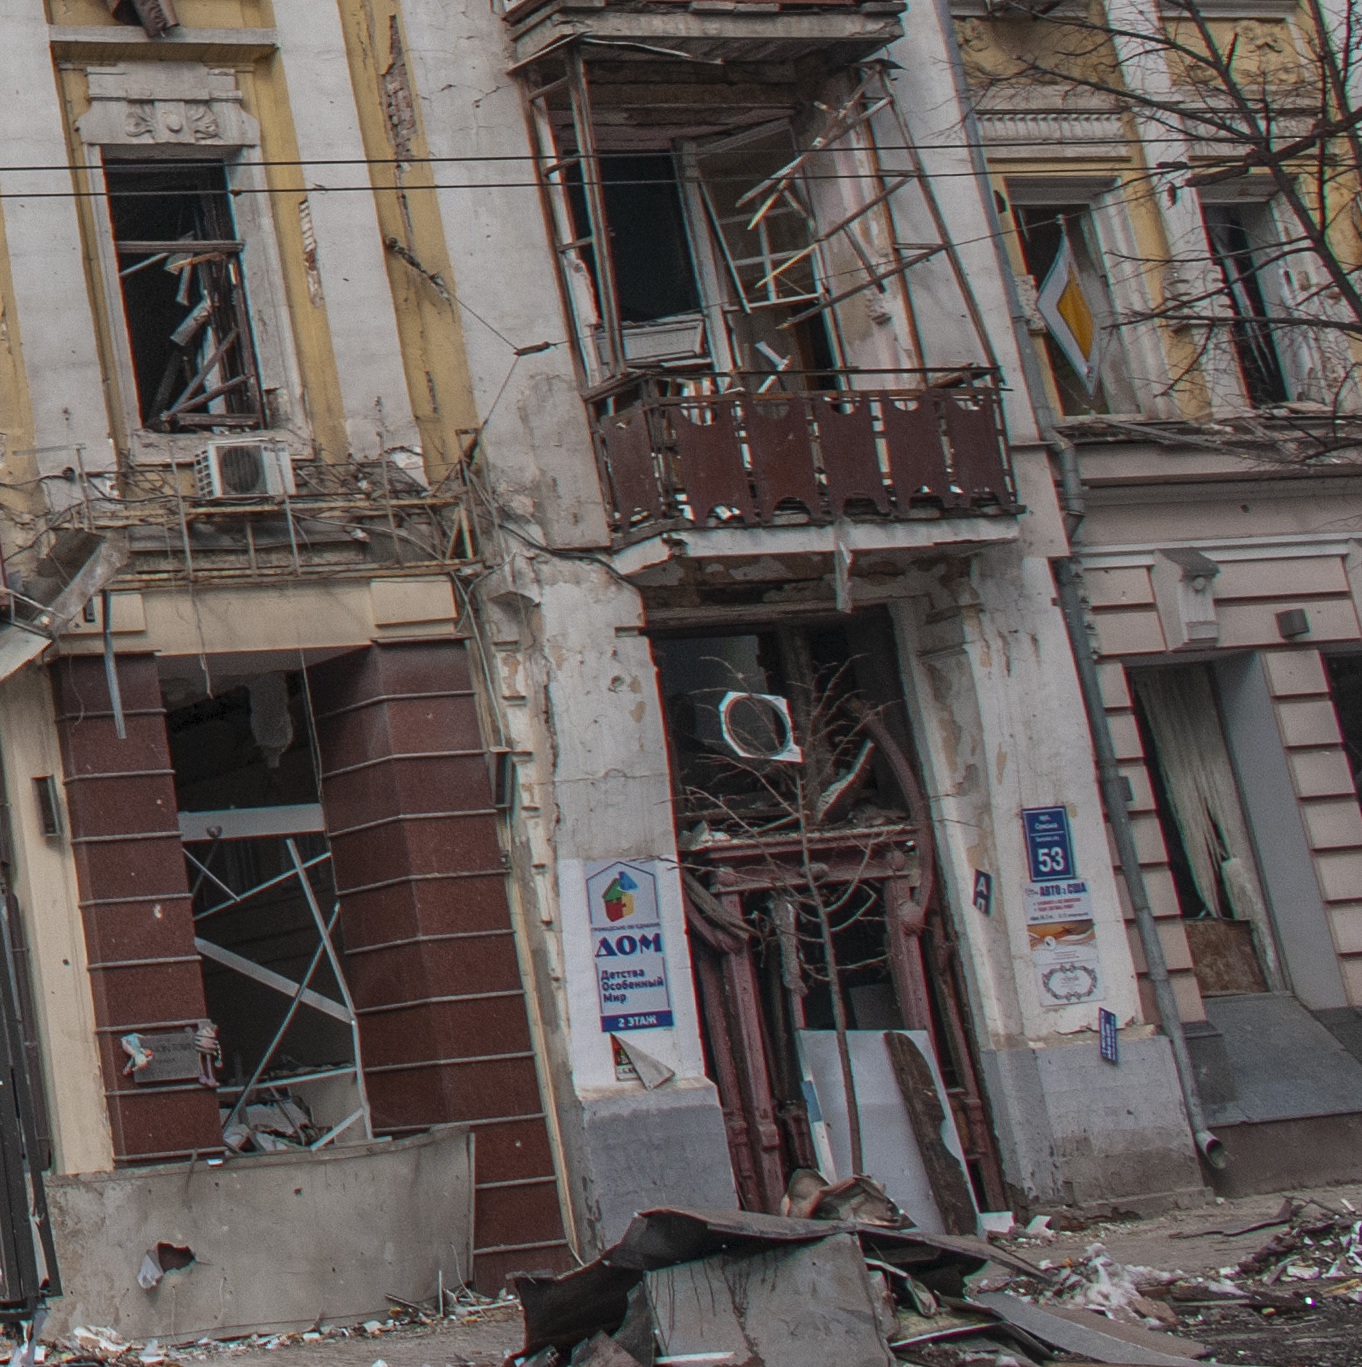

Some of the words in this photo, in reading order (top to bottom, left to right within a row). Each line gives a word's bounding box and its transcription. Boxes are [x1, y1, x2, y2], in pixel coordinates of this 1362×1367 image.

[1038, 846, 1065, 872] 53
[595, 932, 663, 958] ДОМ
[601, 968, 644, 981] Детства
[601, 976, 664, 991] Особенный
[603, 993, 627, 1004] Мир
[618, 1018, 625, 1028] 2
[627, 1014, 658, 1027] ЭТАЖ
